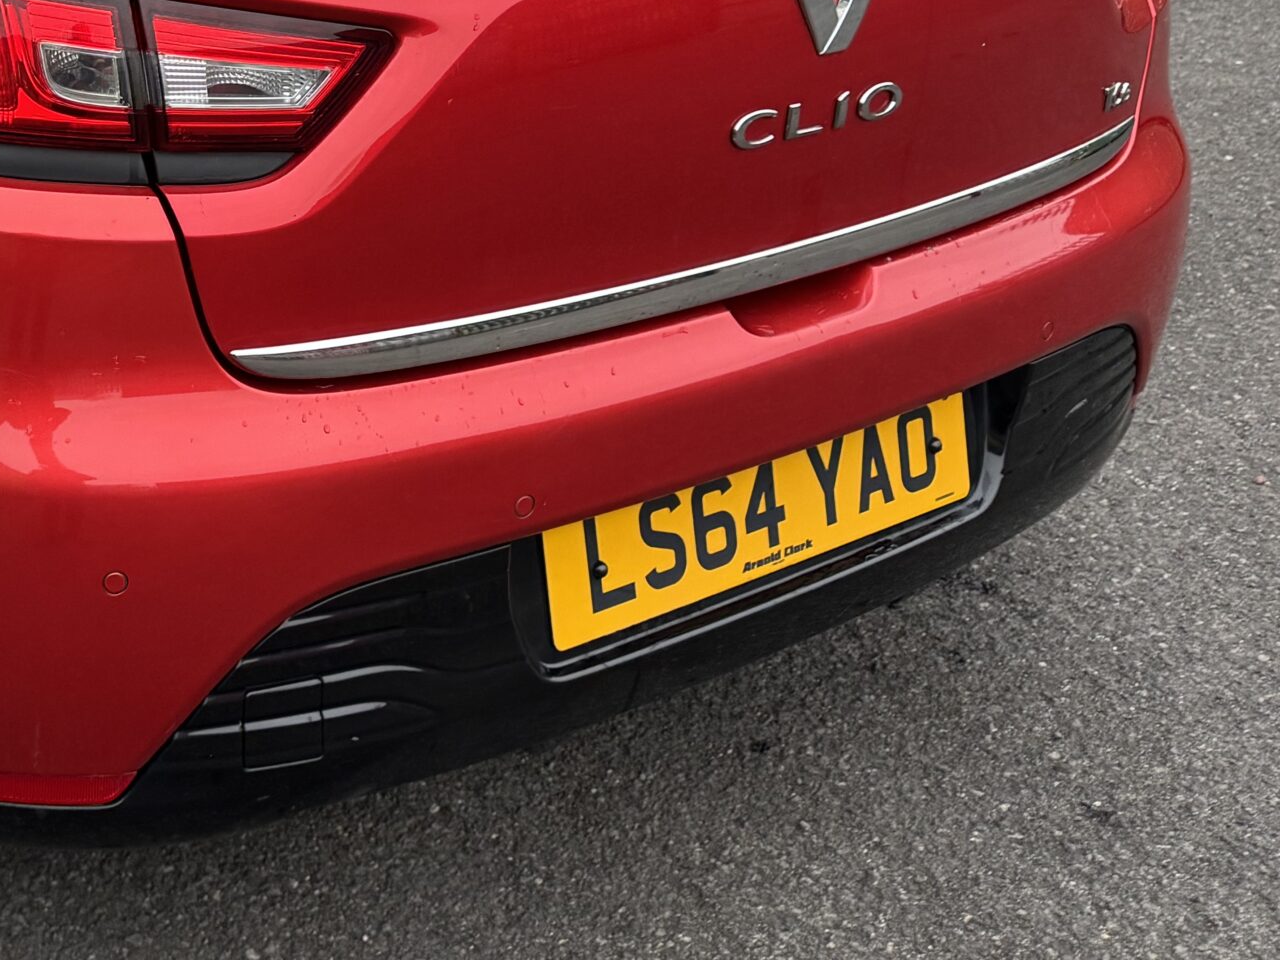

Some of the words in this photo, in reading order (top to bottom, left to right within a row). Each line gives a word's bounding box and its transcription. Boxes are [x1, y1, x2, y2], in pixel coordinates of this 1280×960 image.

[731, 81, 903, 150] CLIO
[583, 459, 786, 614] LS64
[742, 550, 782, 574] Arnold
[783, 539, 814, 558] Clark
